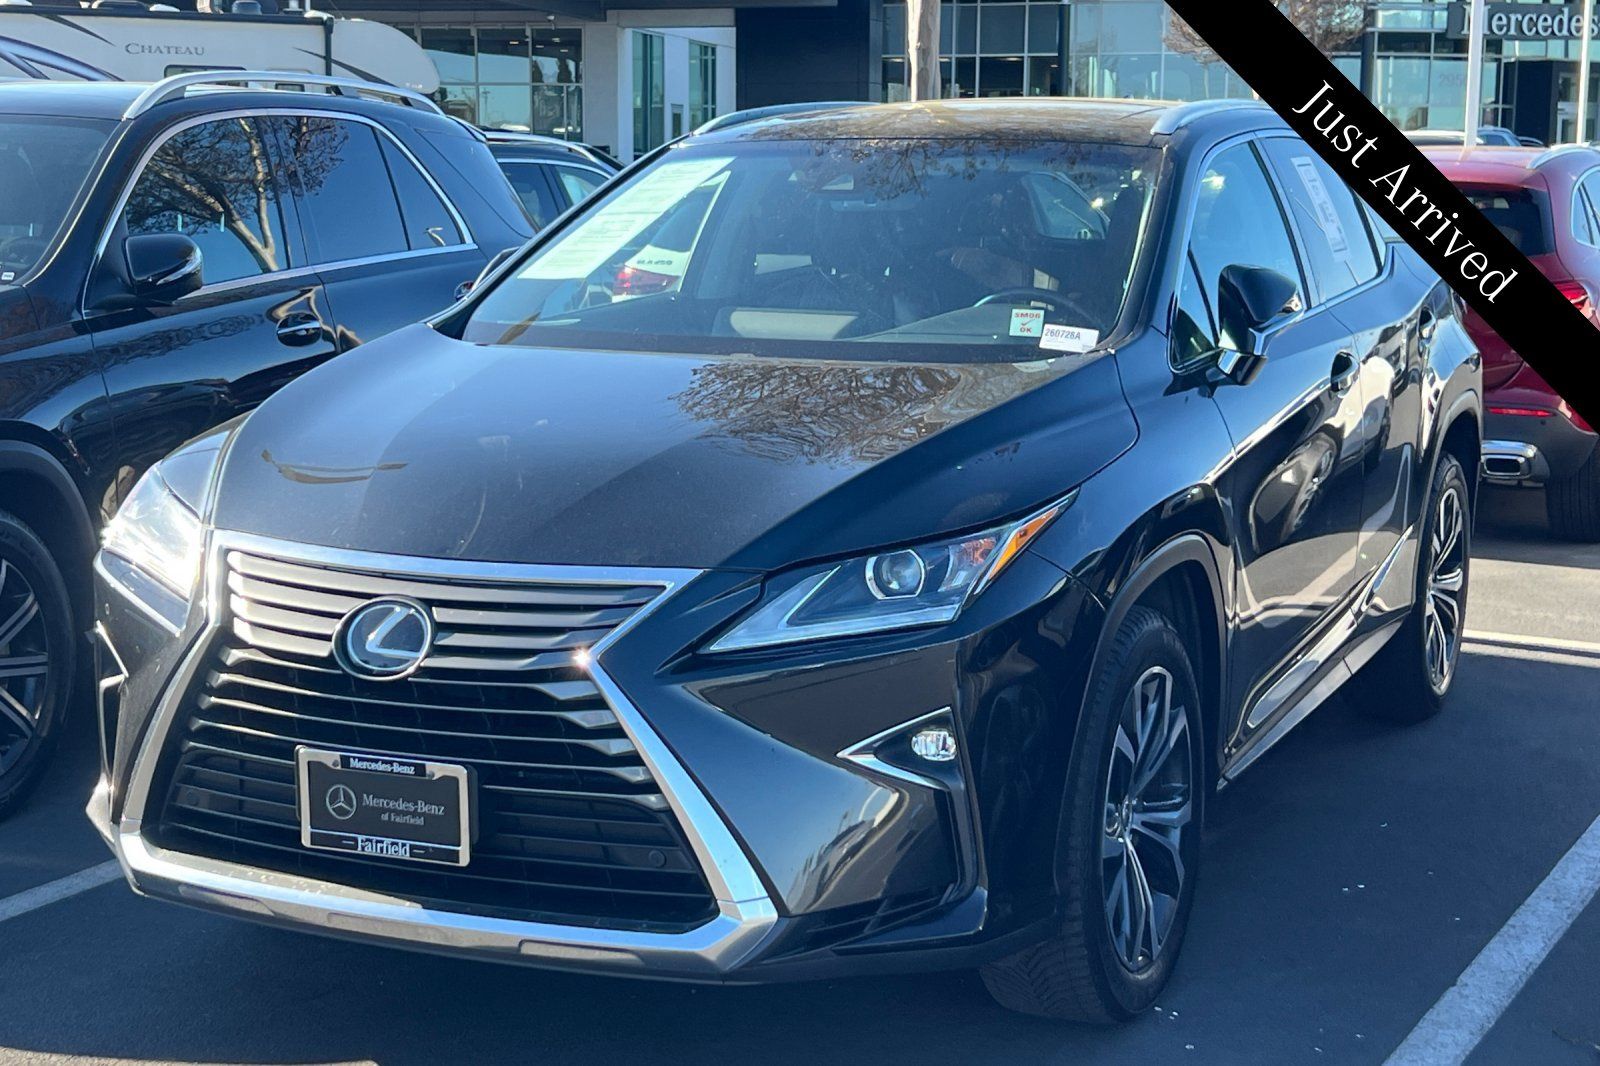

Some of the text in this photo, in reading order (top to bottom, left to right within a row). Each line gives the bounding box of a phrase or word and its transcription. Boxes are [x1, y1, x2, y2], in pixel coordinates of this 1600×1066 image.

[124, 42, 205, 56] CHATEAU
[1044, 327, 1081, 341] 260728A
[349, 757, 416, 775] Mercedes-Benz
[361, 793, 446, 817] Mercedes-Benz
[380, 812, 425, 826] of Fairfield
[356, 835, 411, 857] Fairfield
